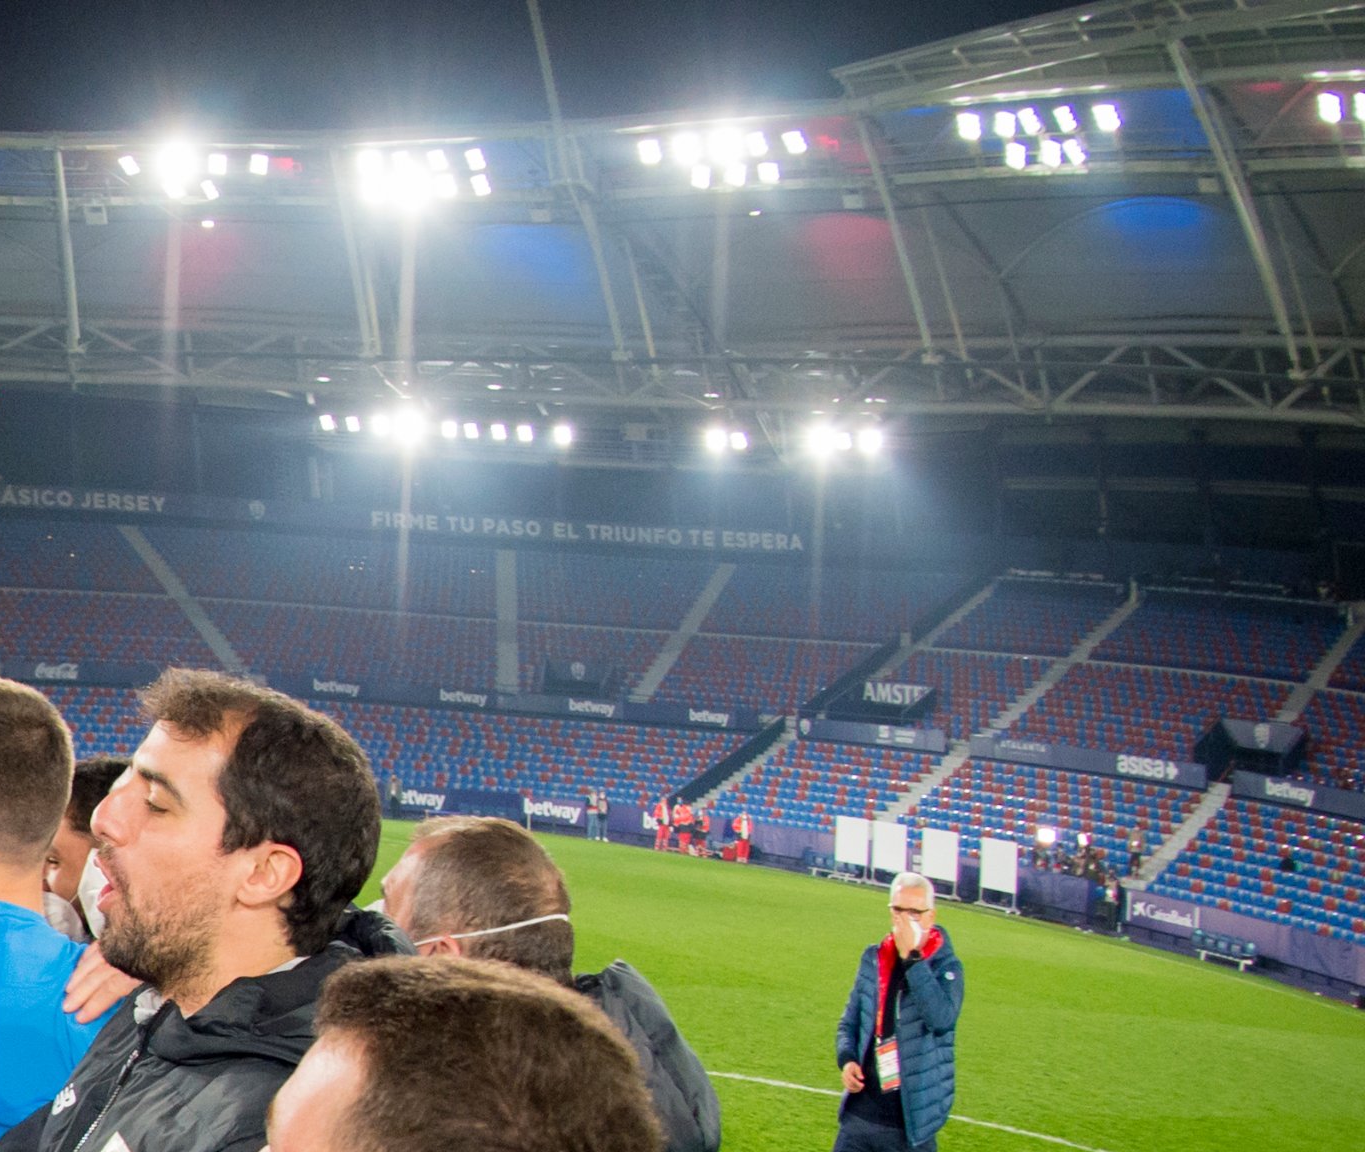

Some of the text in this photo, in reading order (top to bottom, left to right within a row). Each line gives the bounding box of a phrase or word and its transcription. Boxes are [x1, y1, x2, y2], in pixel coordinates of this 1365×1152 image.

[80, 491, 165, 513] JERSEY
[370, 510, 804, 552] FIRME TU PASO EL TRIUNFO TE ESPERA
[439, 688, 487, 707] betway
[569, 698, 616, 718] betway
[689, 708, 730, 727] betway
[1116, 754, 1166, 779] asisa
[400, 789, 446, 811] etway
[1265, 777, 1315, 807] betway
[523, 797, 581, 824] betway
